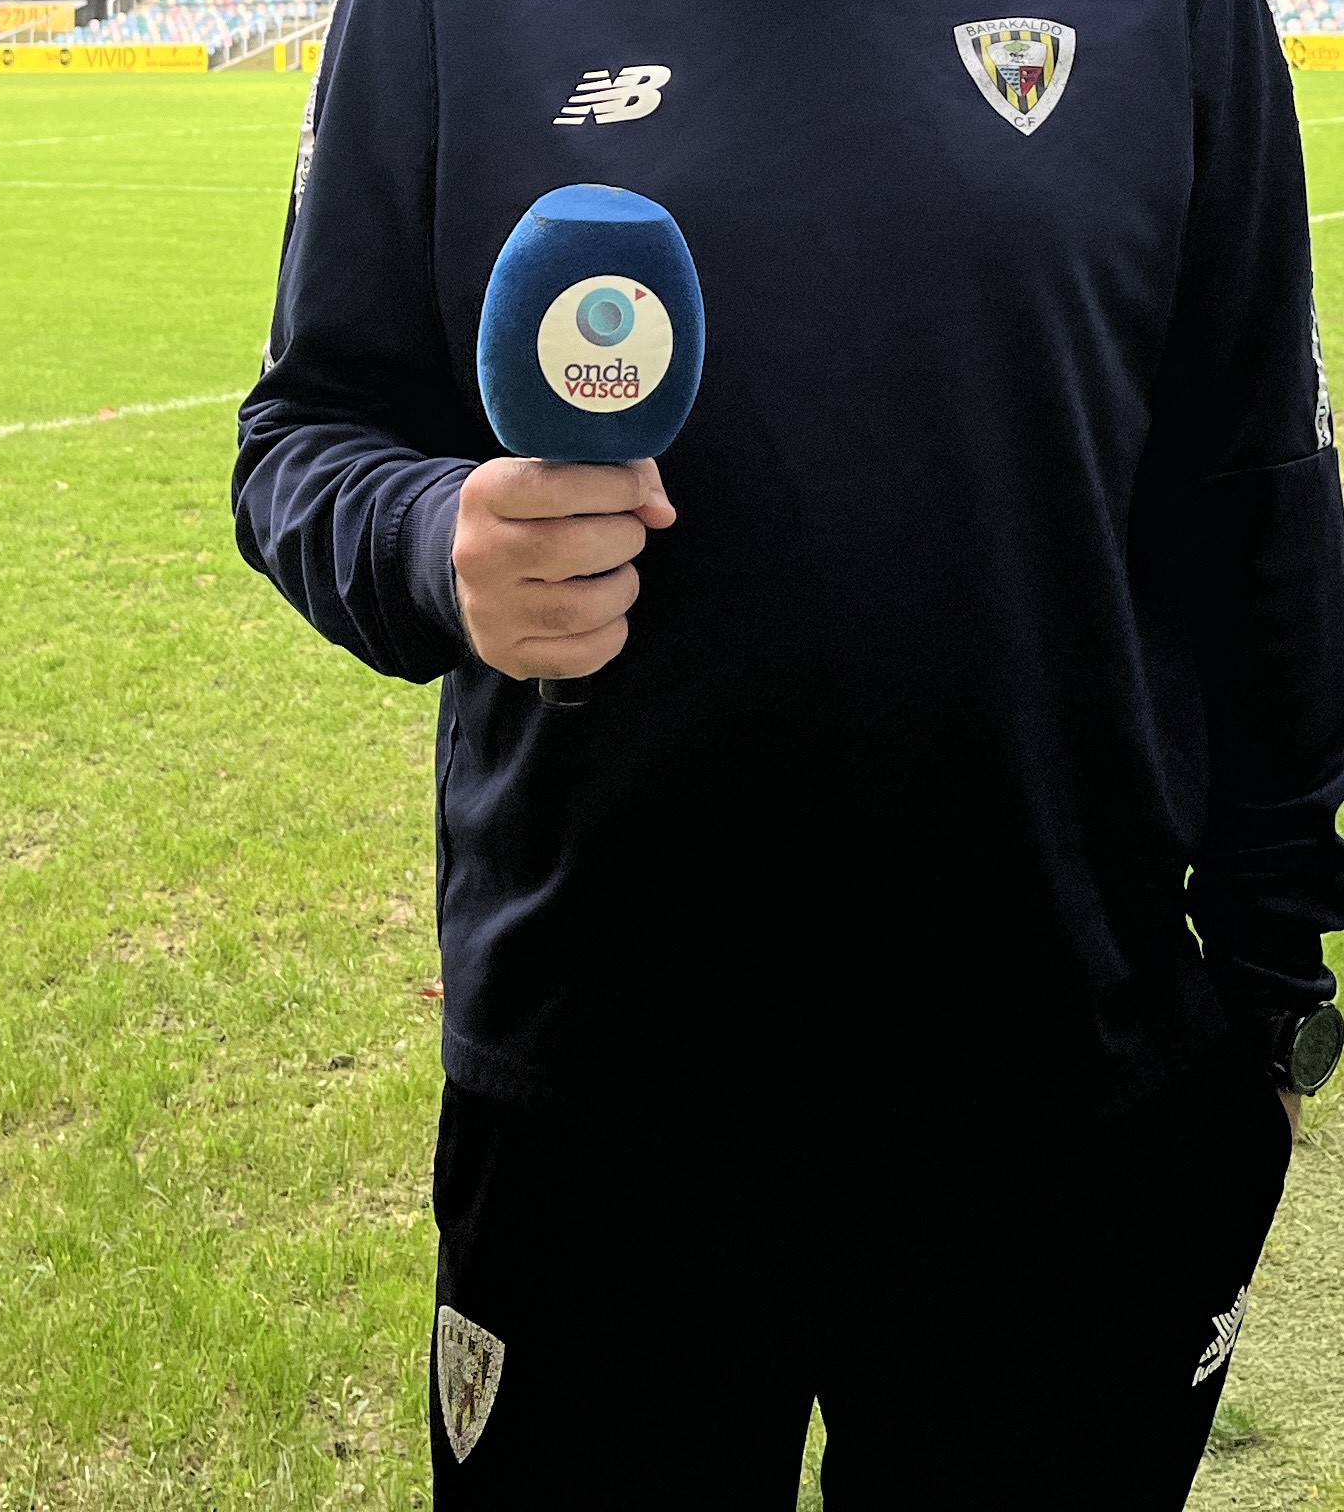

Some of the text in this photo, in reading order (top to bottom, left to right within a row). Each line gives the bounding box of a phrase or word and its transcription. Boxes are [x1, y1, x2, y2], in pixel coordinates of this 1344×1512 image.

[966, 19, 1062, 37] BARAKALDO
[564, 358, 640, 382] onda
[564, 379, 640, 399] vasca
